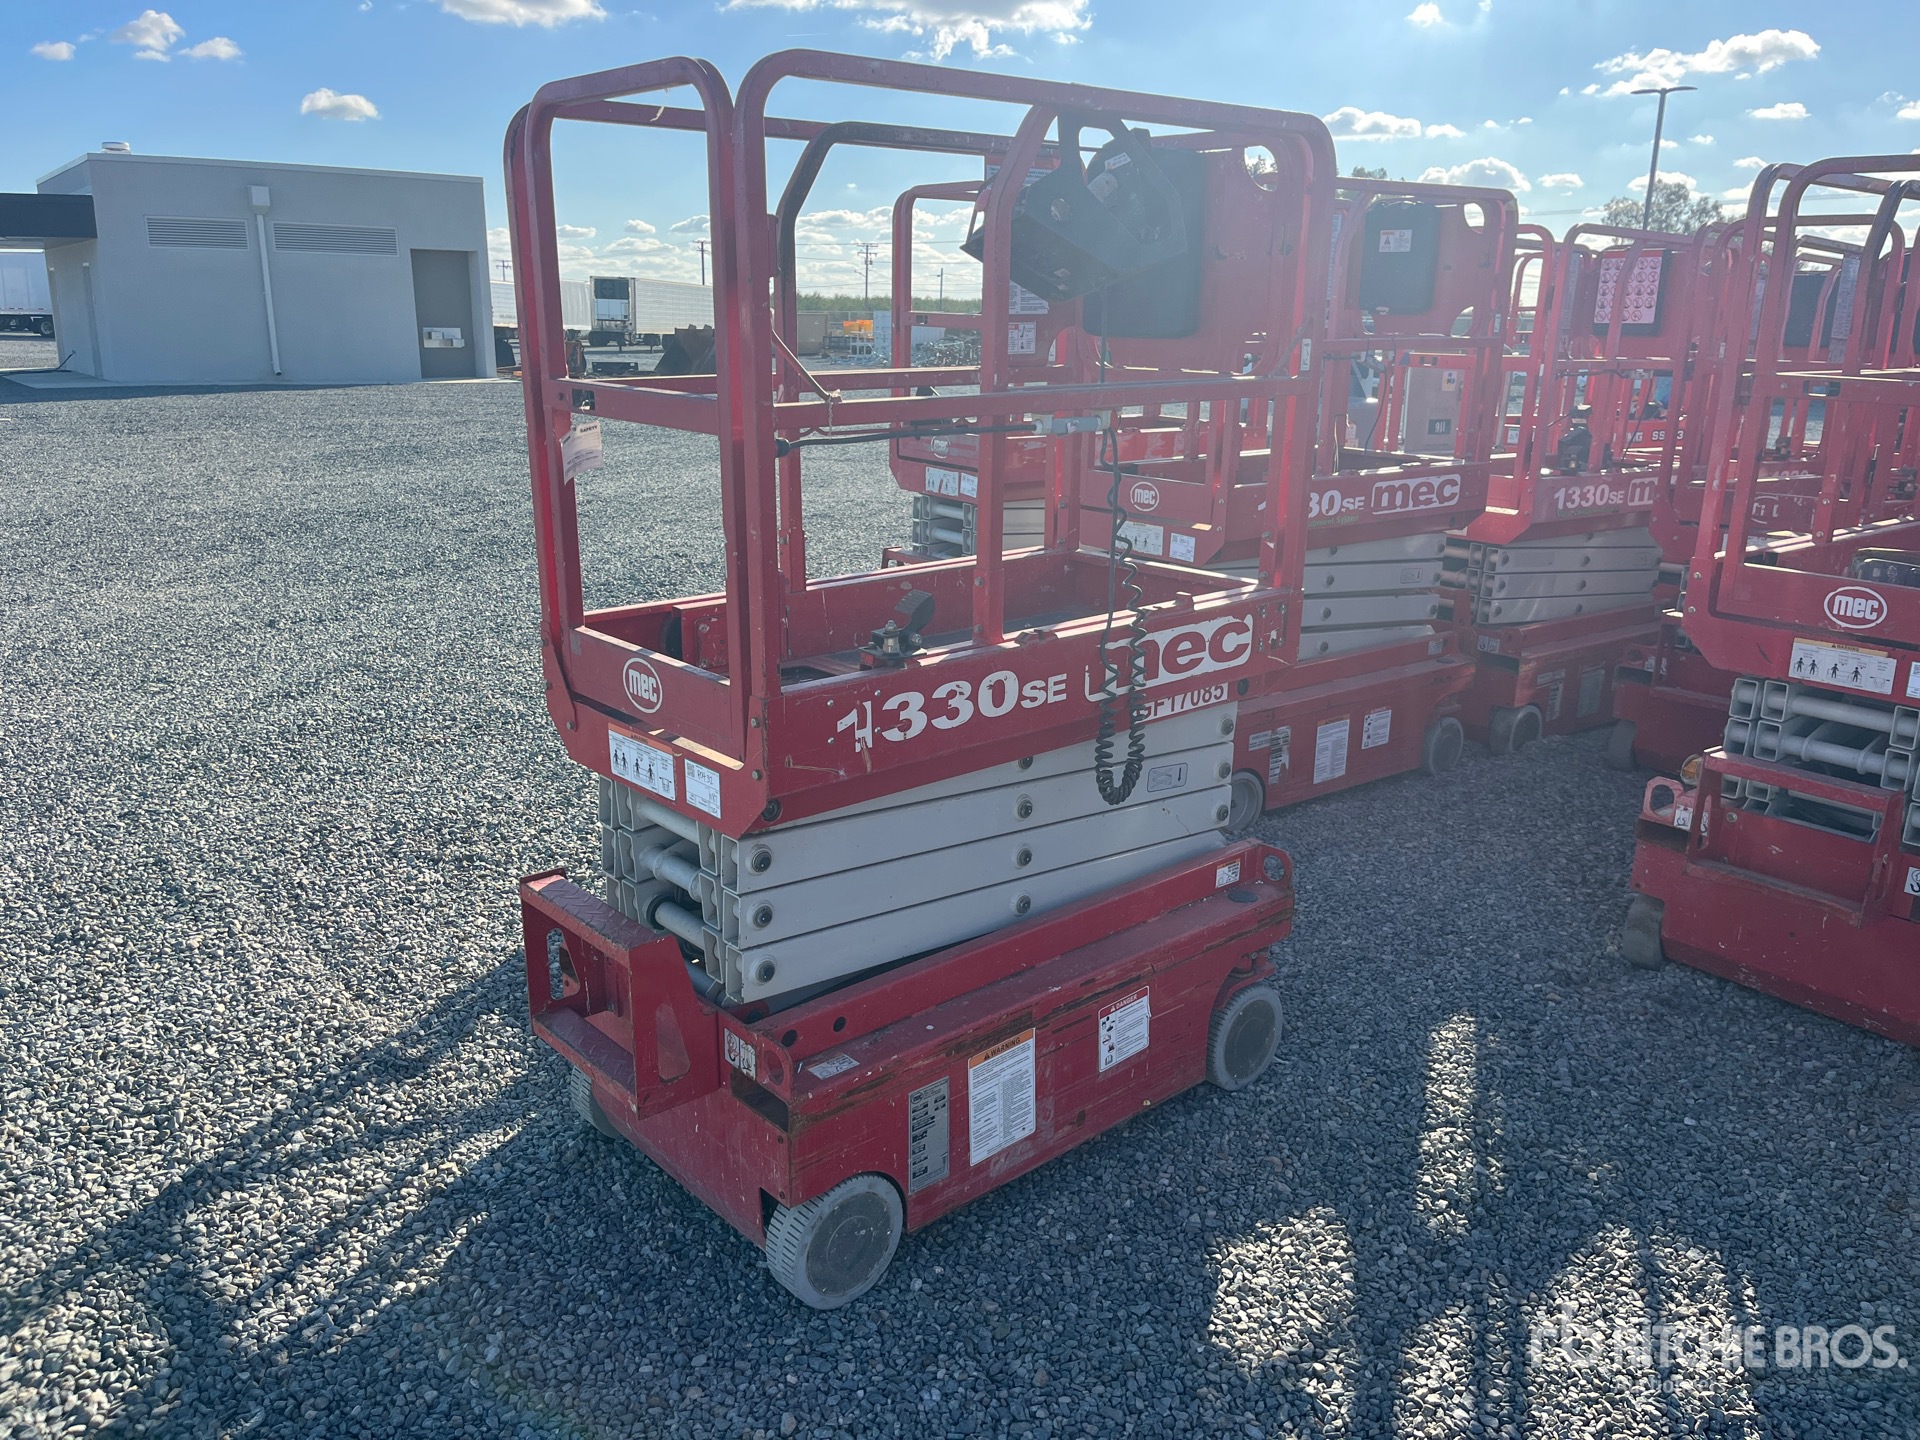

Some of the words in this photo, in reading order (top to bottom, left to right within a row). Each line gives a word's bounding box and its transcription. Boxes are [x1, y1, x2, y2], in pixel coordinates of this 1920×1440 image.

[1134, 488, 1156, 505] mec
[1373, 478, 1459, 512] mec
[1554, 484, 1624, 510] 1330SE
[1832, 595, 1879, 620] mec
[628, 668, 657, 703] mec
[836, 671, 1068, 753] 1330SE
[1089, 621, 1251, 697] mec
[1115, 994, 1137, 1010] DANGER
[991, 1037, 1021, 1056] WARNING
